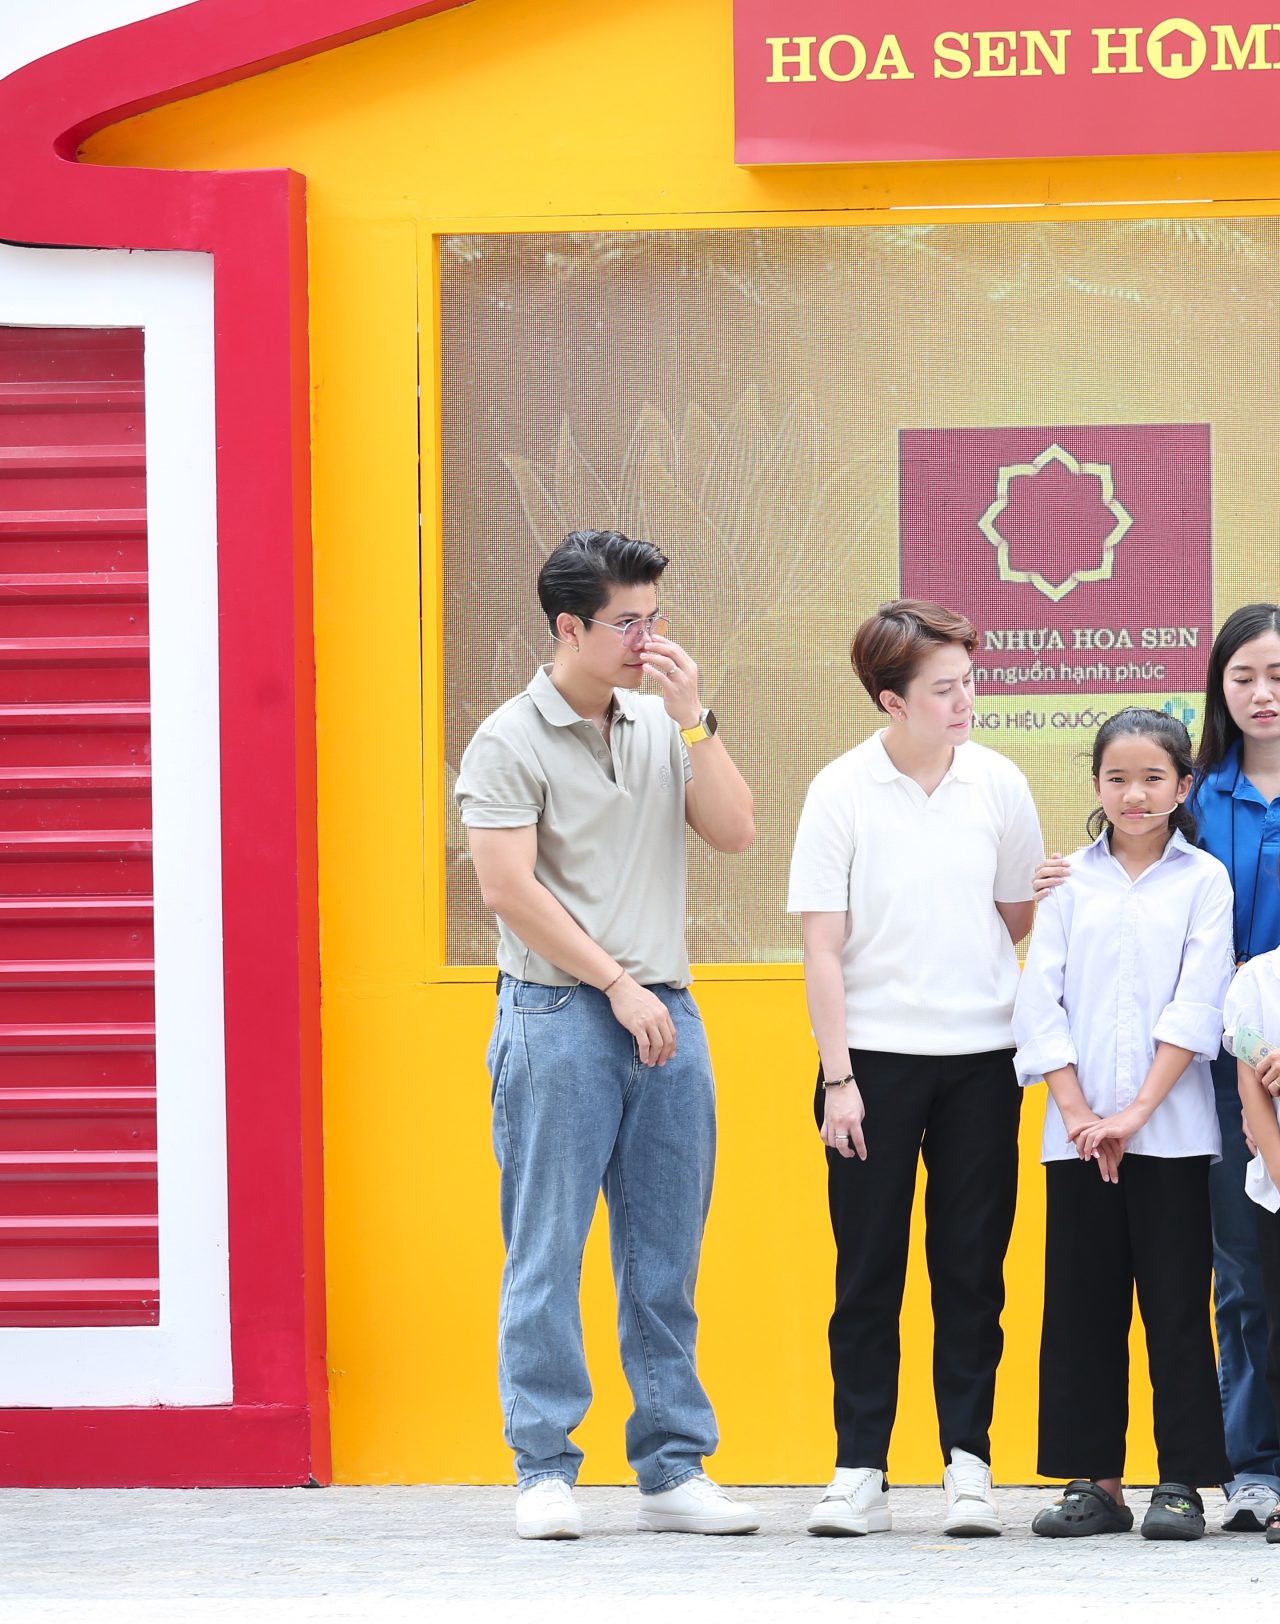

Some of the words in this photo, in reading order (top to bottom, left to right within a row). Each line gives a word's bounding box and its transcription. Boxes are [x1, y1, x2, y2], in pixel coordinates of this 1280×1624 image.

[765, 34, 915, 83] HOA
[933, 29, 1071, 79] SEN
[984, 628, 1065, 655] NHỰA
[1072, 628, 1133, 649] HOA
[1141, 627, 1199, 649] SEN
[993, 660, 1056, 685] nguồn
[1060, 661, 1110, 684] hạnh
[1116, 660, 1166, 682] phúc
[1006, 709, 1046, 732] HIỆU
